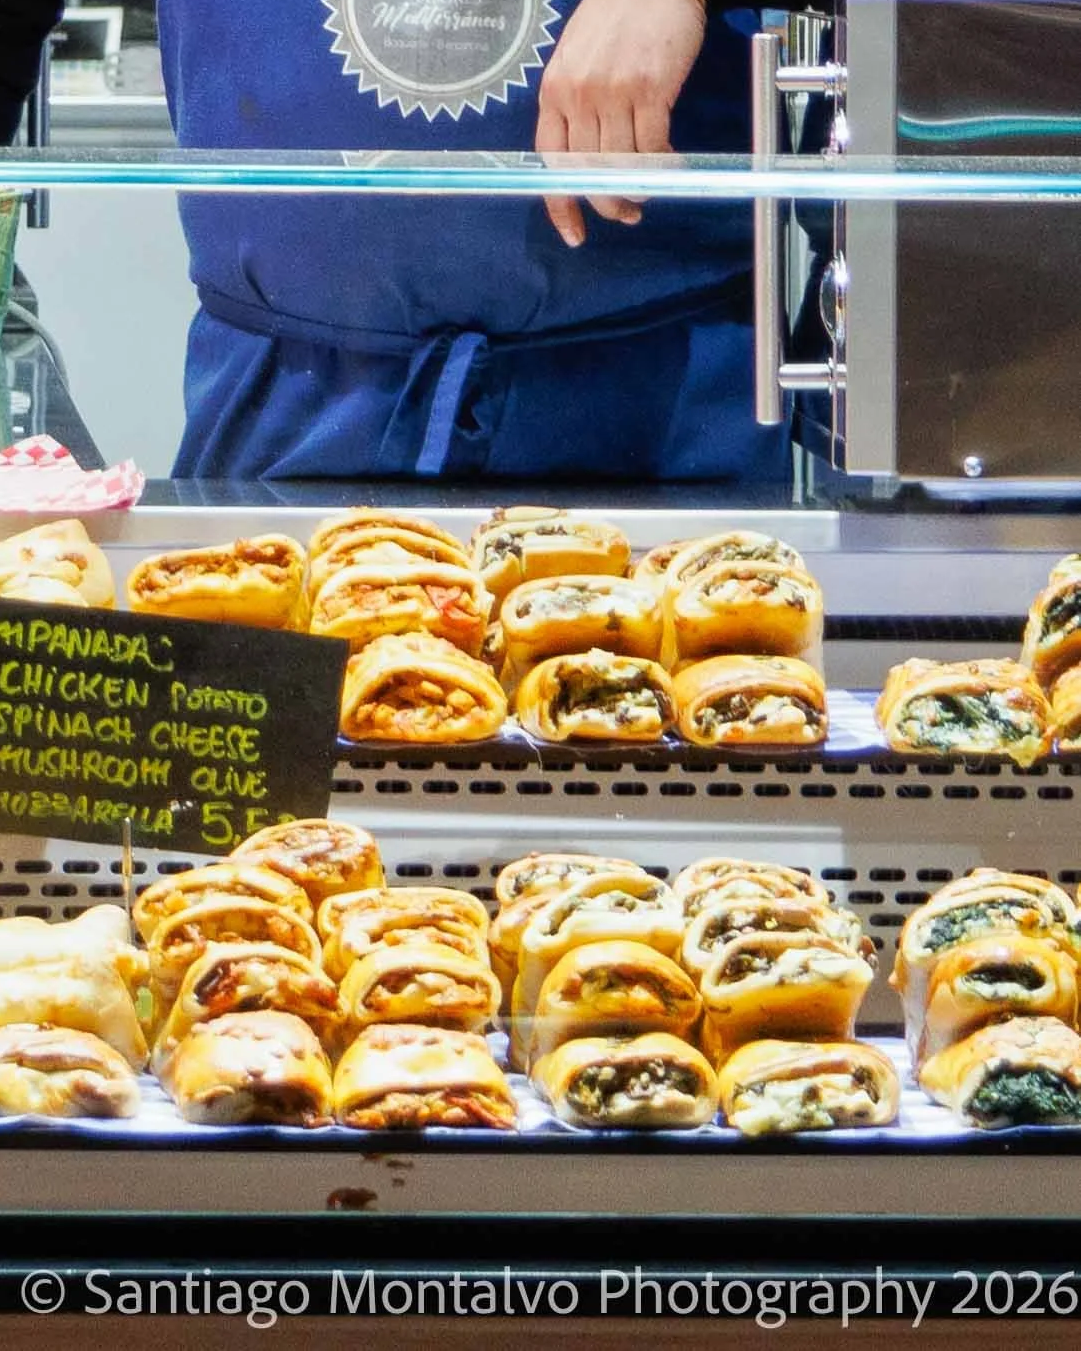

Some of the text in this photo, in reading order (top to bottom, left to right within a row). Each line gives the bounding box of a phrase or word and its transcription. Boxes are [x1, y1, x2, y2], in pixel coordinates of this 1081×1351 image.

[170, 681, 268, 720] POTATO
[149, 721, 261, 763] CHEESE
[190, 766, 268, 799] OLIVE
